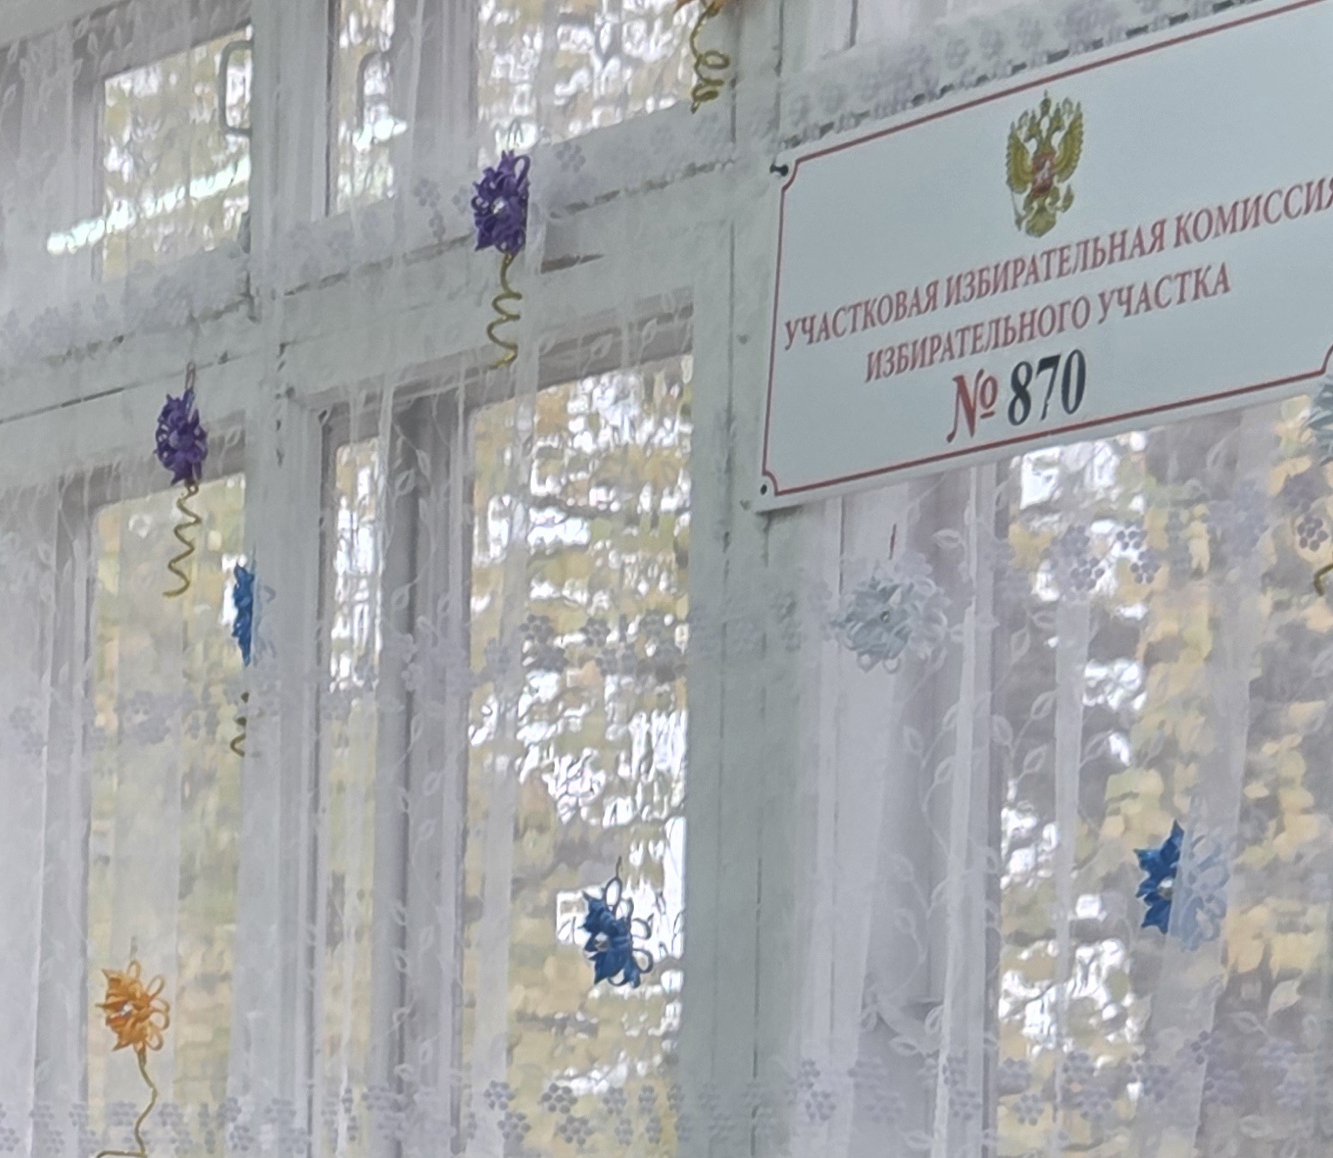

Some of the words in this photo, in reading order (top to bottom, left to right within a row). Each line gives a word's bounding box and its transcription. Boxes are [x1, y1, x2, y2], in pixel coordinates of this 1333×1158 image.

[785, 279, 939, 351] УЧАСТКОВАЯ
[944, 218, 1167, 308] ИЗБИРАТЕЛЬНАЯ
[865, 295, 1091, 384] ИЗБИРАТЕЛЬНОГО
[1098, 261, 1231, 325] УЧАСТКА
[947, 368, 998, 443] №
[1007, 349, 1087, 426] 870
